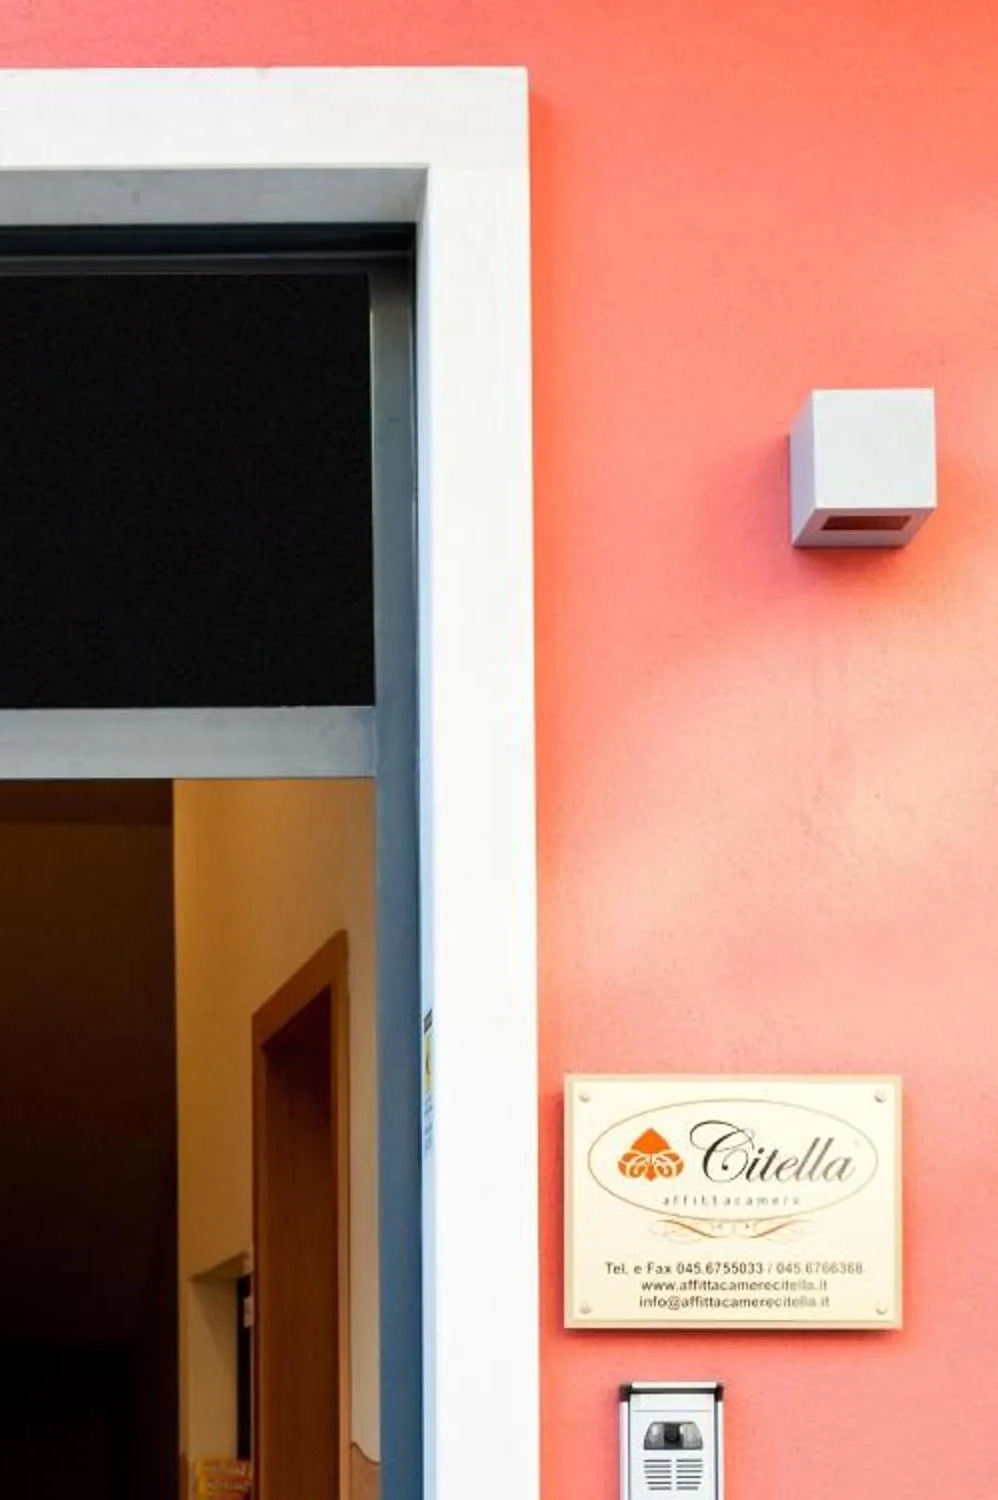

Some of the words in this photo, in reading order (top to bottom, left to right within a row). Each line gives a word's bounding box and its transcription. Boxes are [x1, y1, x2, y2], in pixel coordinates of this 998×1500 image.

[689, 1119, 855, 1183] Citella
[634, 1265, 643, 1275] e
[646, 1261, 672, 1275] Fax
